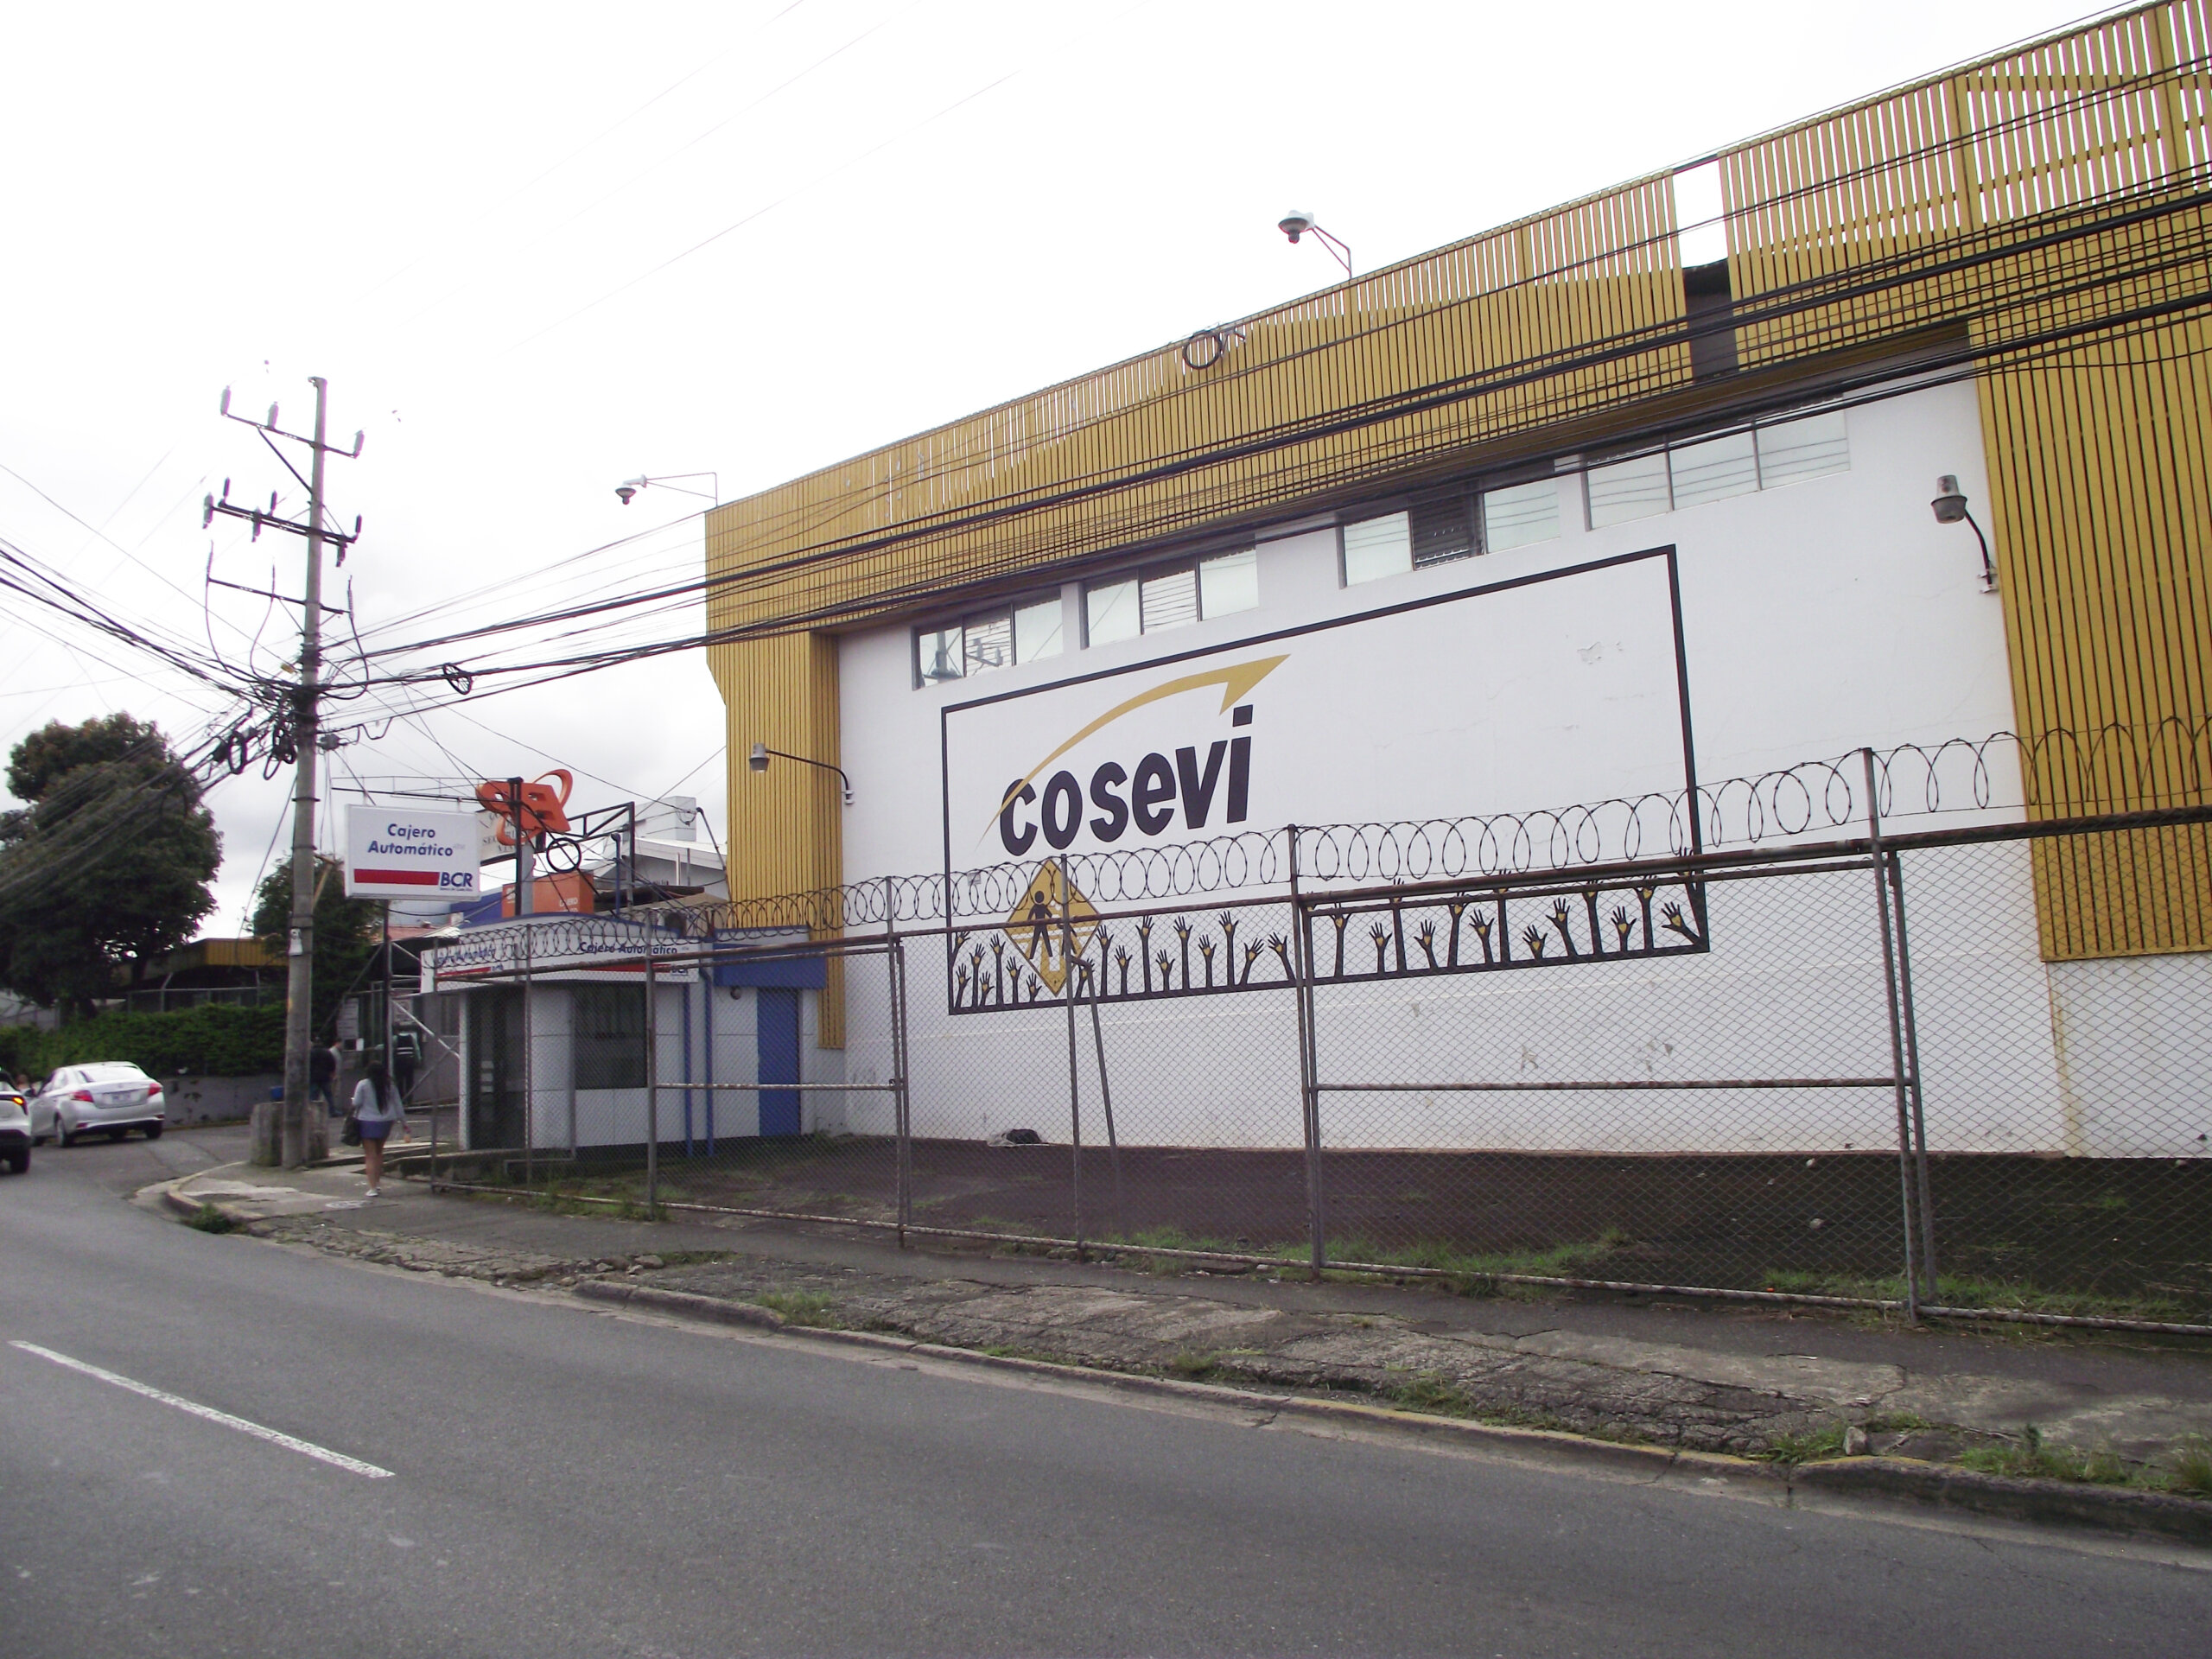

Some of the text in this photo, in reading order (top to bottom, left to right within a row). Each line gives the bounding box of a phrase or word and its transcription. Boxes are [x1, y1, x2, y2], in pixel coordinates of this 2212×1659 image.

[387, 823, 435, 840] Cajero
[366, 840, 454, 856] Automático
[439, 871, 474, 887] BCR
[580, 941, 615, 955] Cajero
